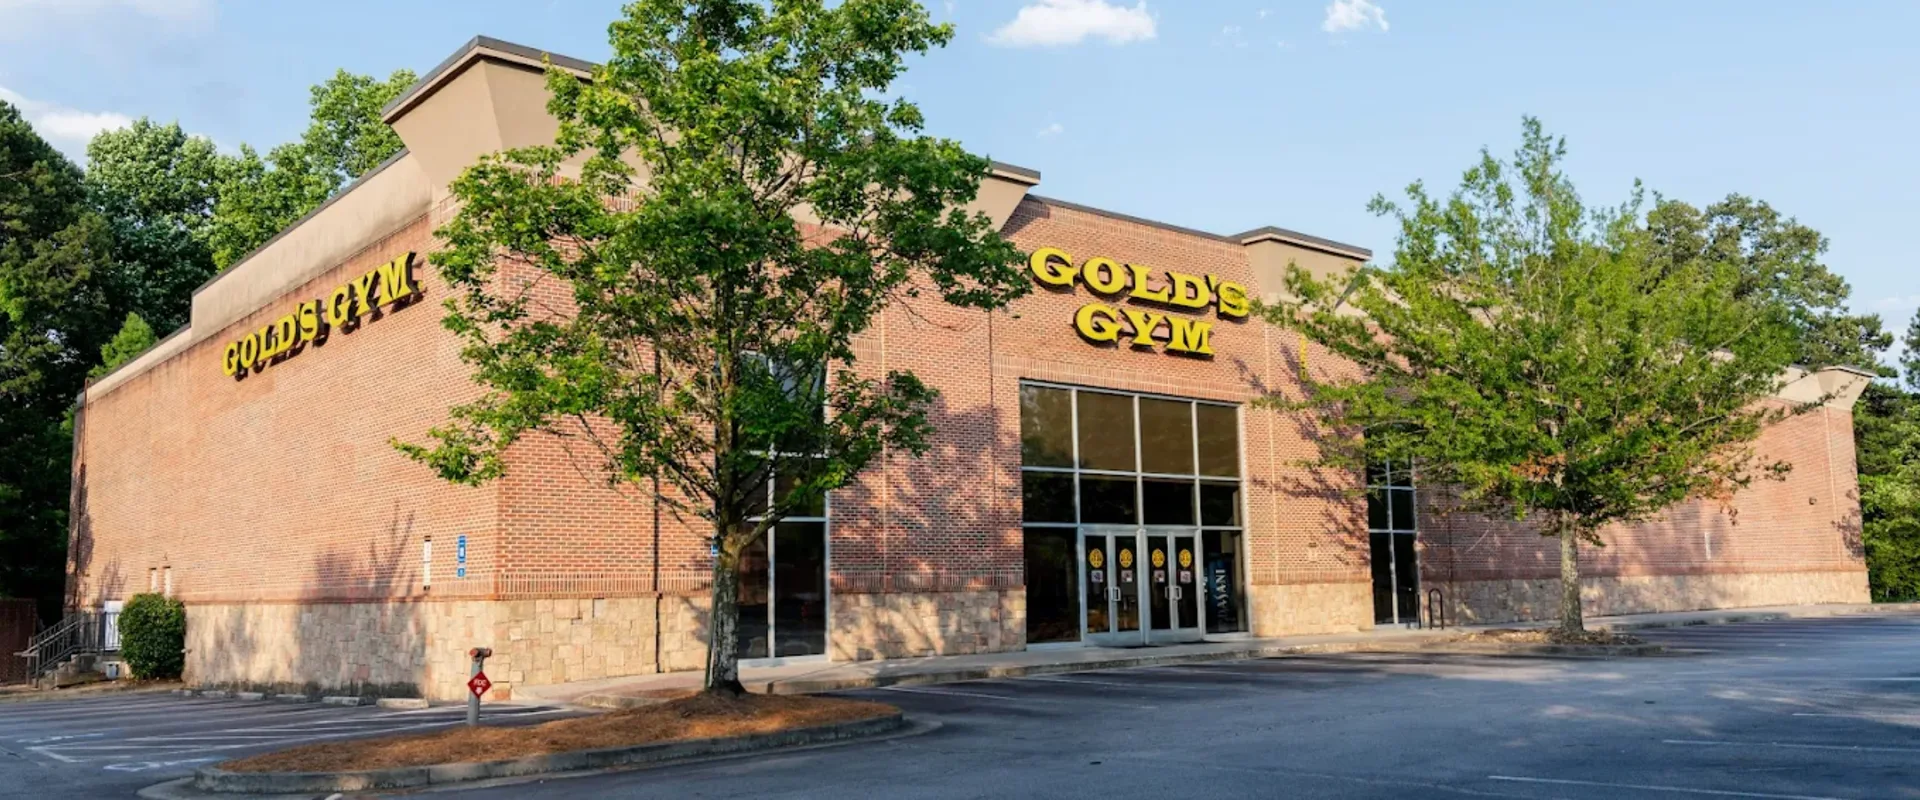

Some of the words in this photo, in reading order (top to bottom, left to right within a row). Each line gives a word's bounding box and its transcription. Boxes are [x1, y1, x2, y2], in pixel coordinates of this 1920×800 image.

[1029, 246, 1250, 318] GOLD'S
[222, 299, 320, 377] GOLD'S
[327, 251, 414, 328] GYM
[1075, 302, 1215, 356] GYM
[1215, 569, 1229, 617] DASANI
